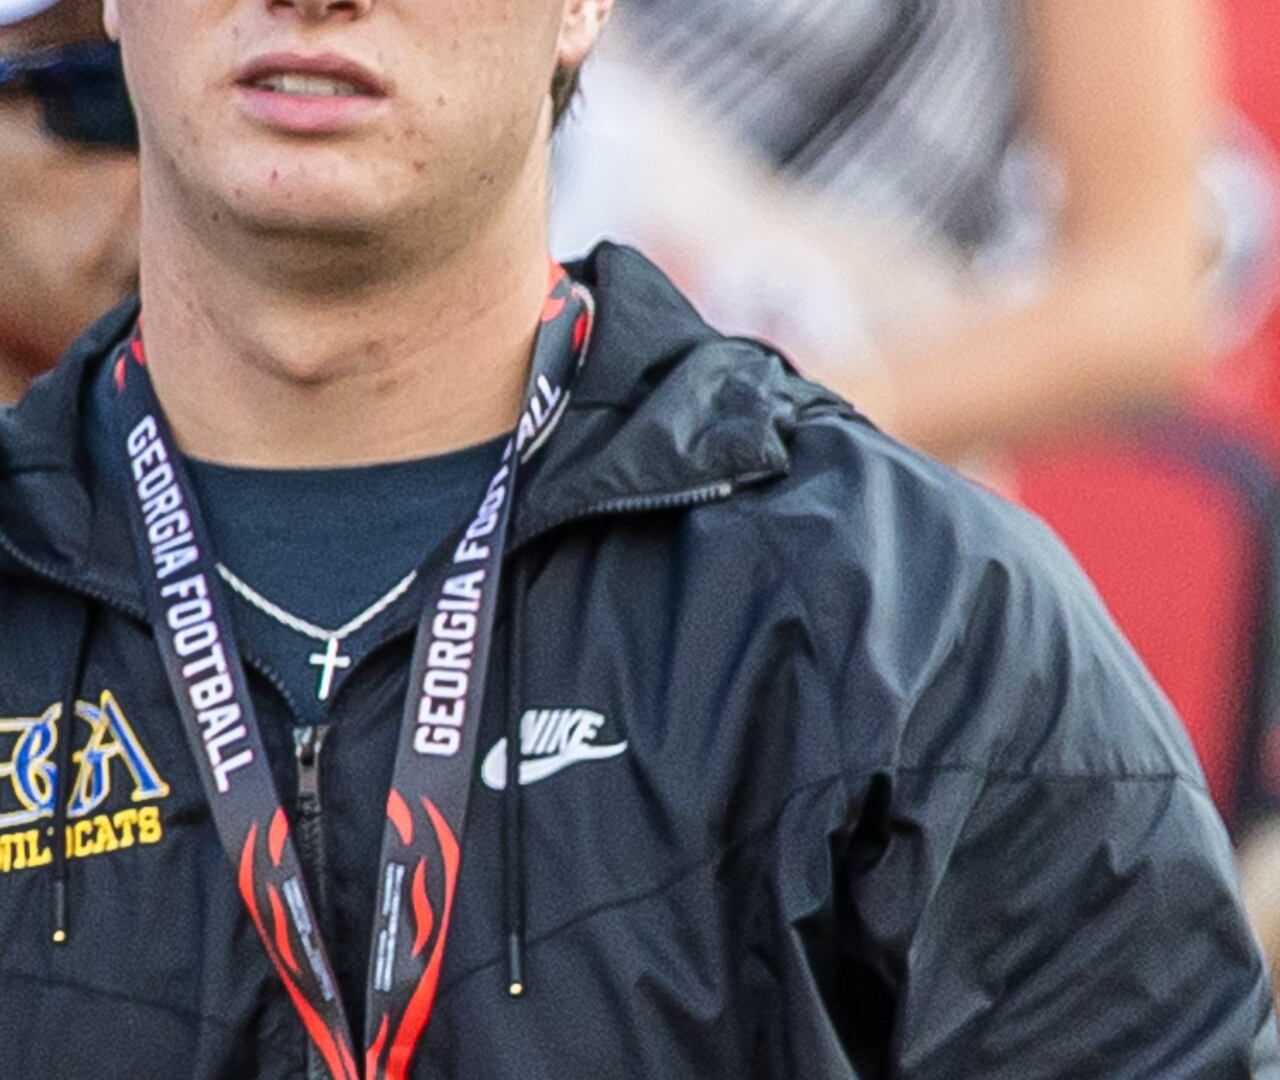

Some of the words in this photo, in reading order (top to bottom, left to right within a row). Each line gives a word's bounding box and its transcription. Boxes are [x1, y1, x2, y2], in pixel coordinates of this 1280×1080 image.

[127, 415, 198, 580] GEORGIA
[413, 569, 486, 756] GEORGIA
[452, 373, 562, 565] FOOTALL
[161, 572, 254, 792] FOOTBALL
[519, 708, 606, 756] NIKE
